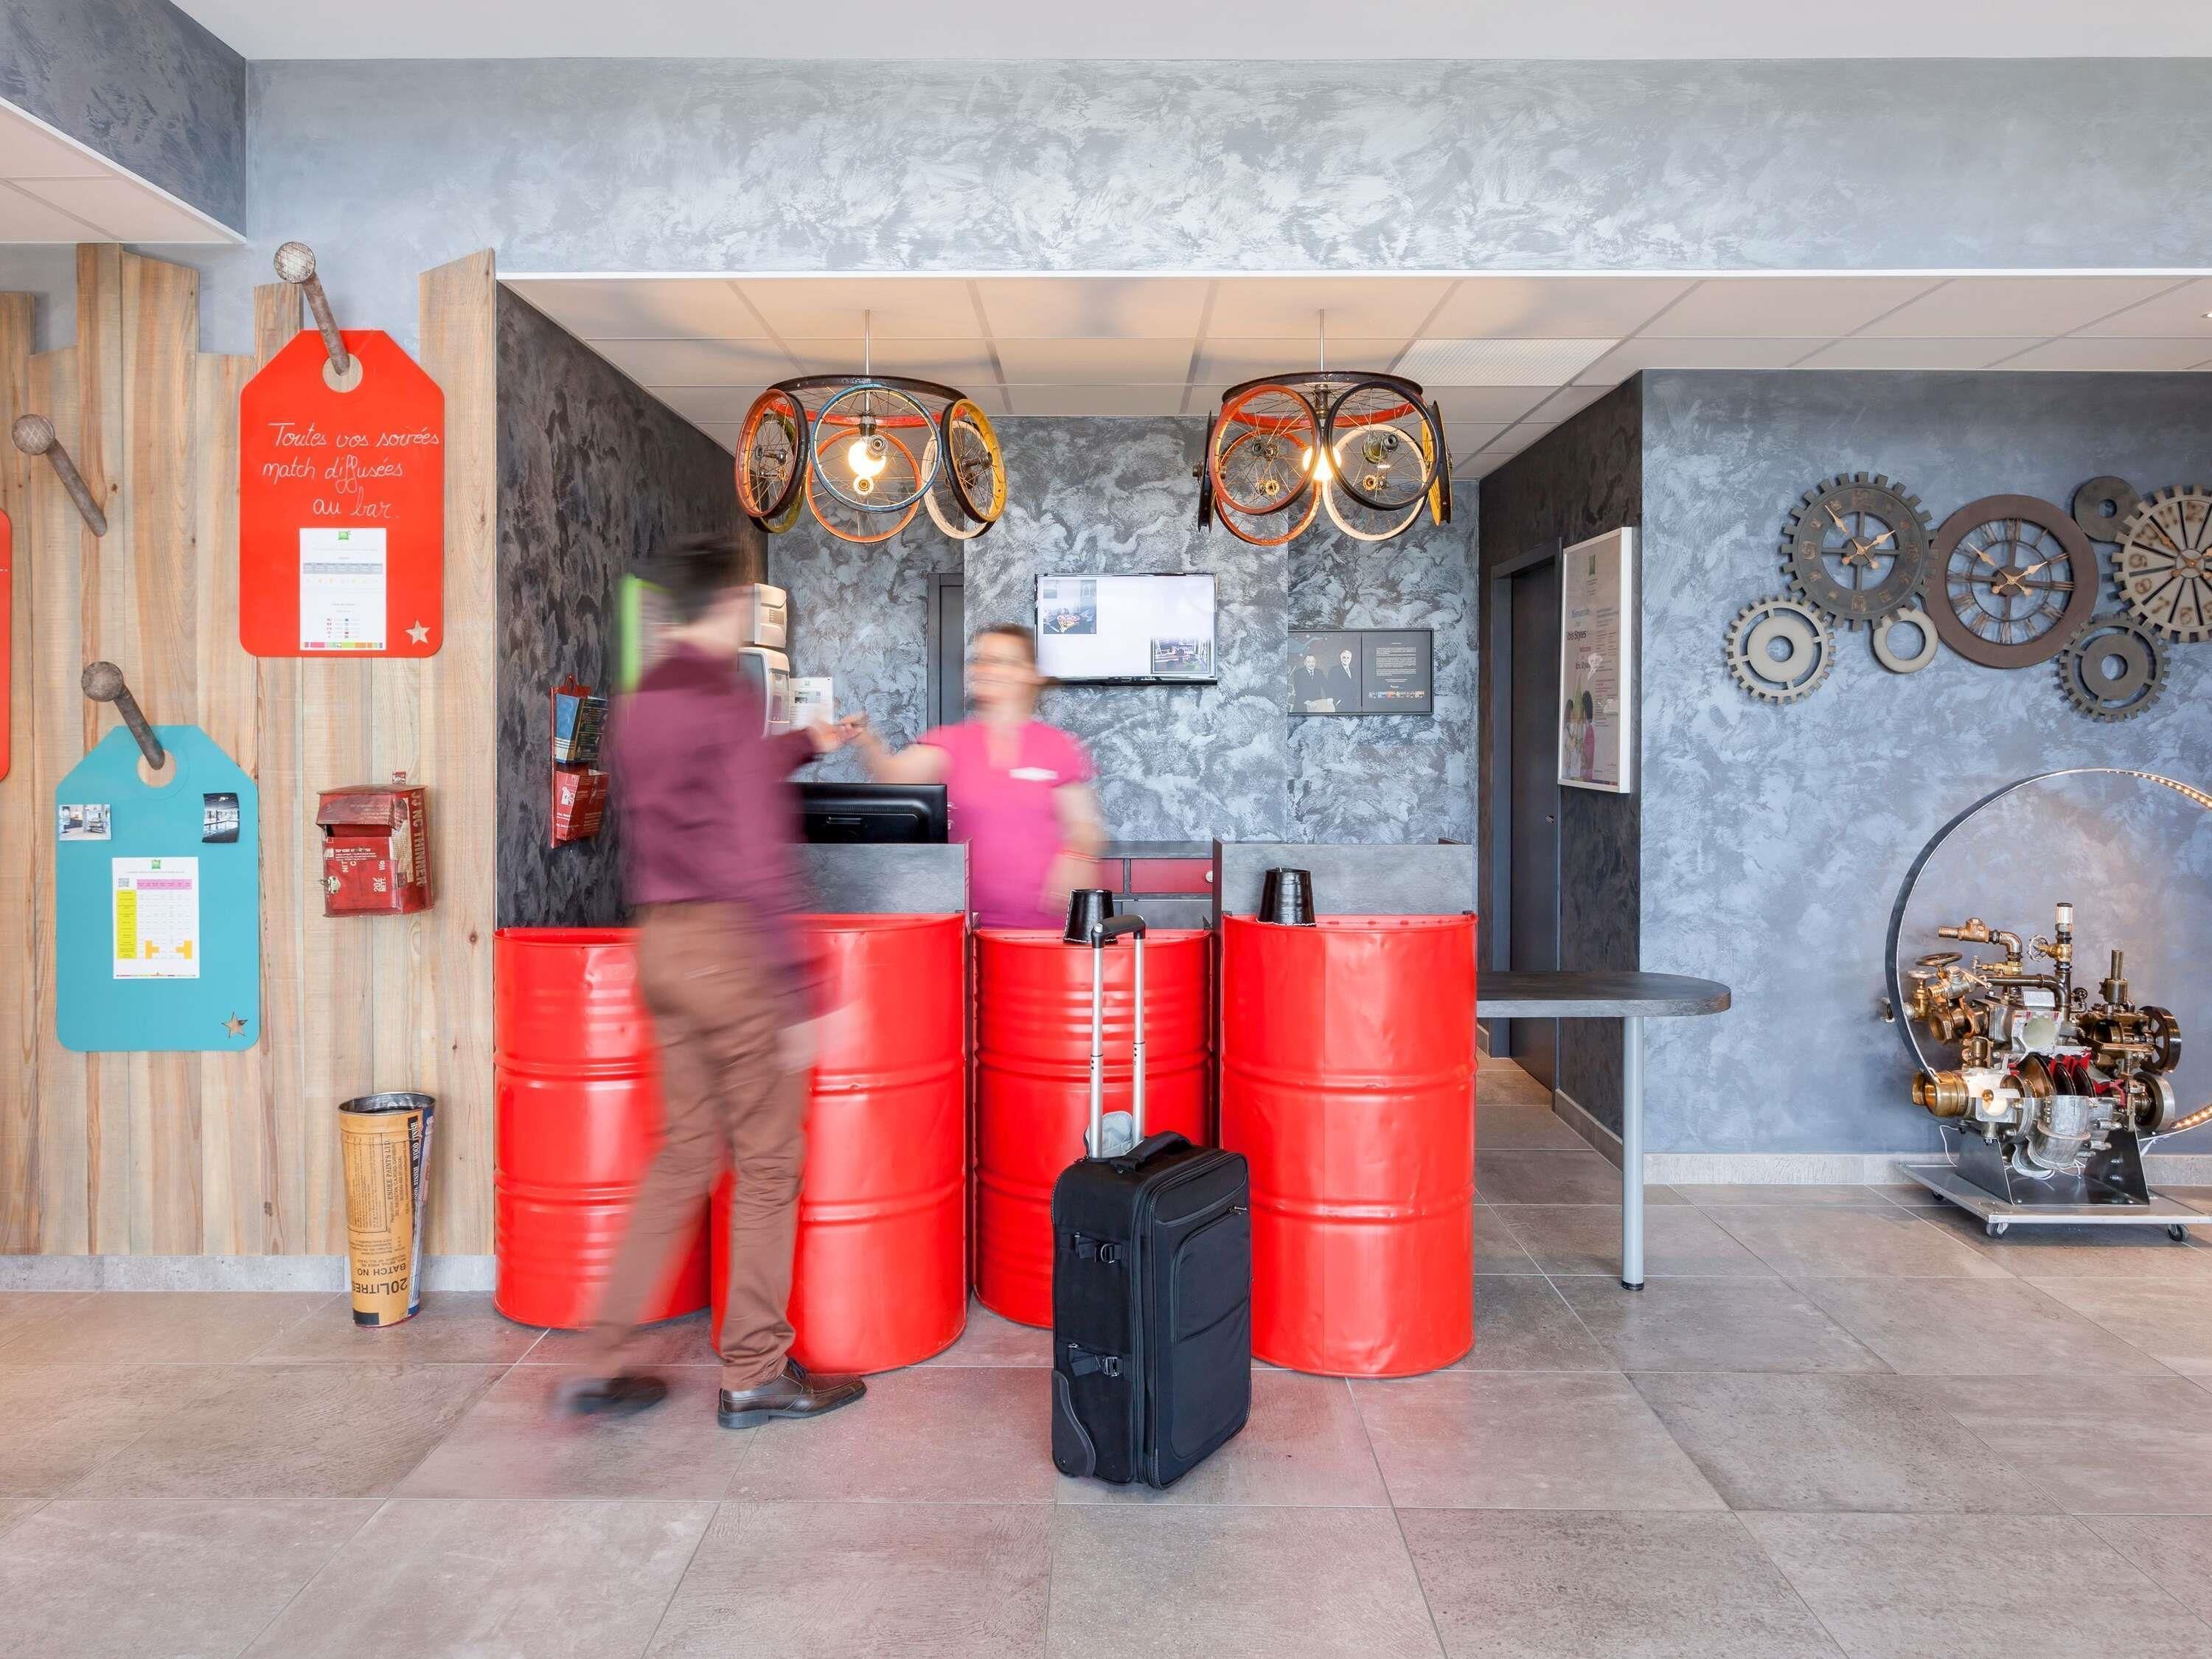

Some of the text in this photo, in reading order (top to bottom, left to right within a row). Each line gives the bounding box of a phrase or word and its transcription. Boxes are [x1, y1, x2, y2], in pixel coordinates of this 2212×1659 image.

[268, 422, 439, 448] Toutes vos soirées
[262, 454, 403, 495] match diffusées
[313, 498, 343, 515] au
[414, 832, 427, 887] THINNER
[373, 1262, 406, 1276] BATCH
